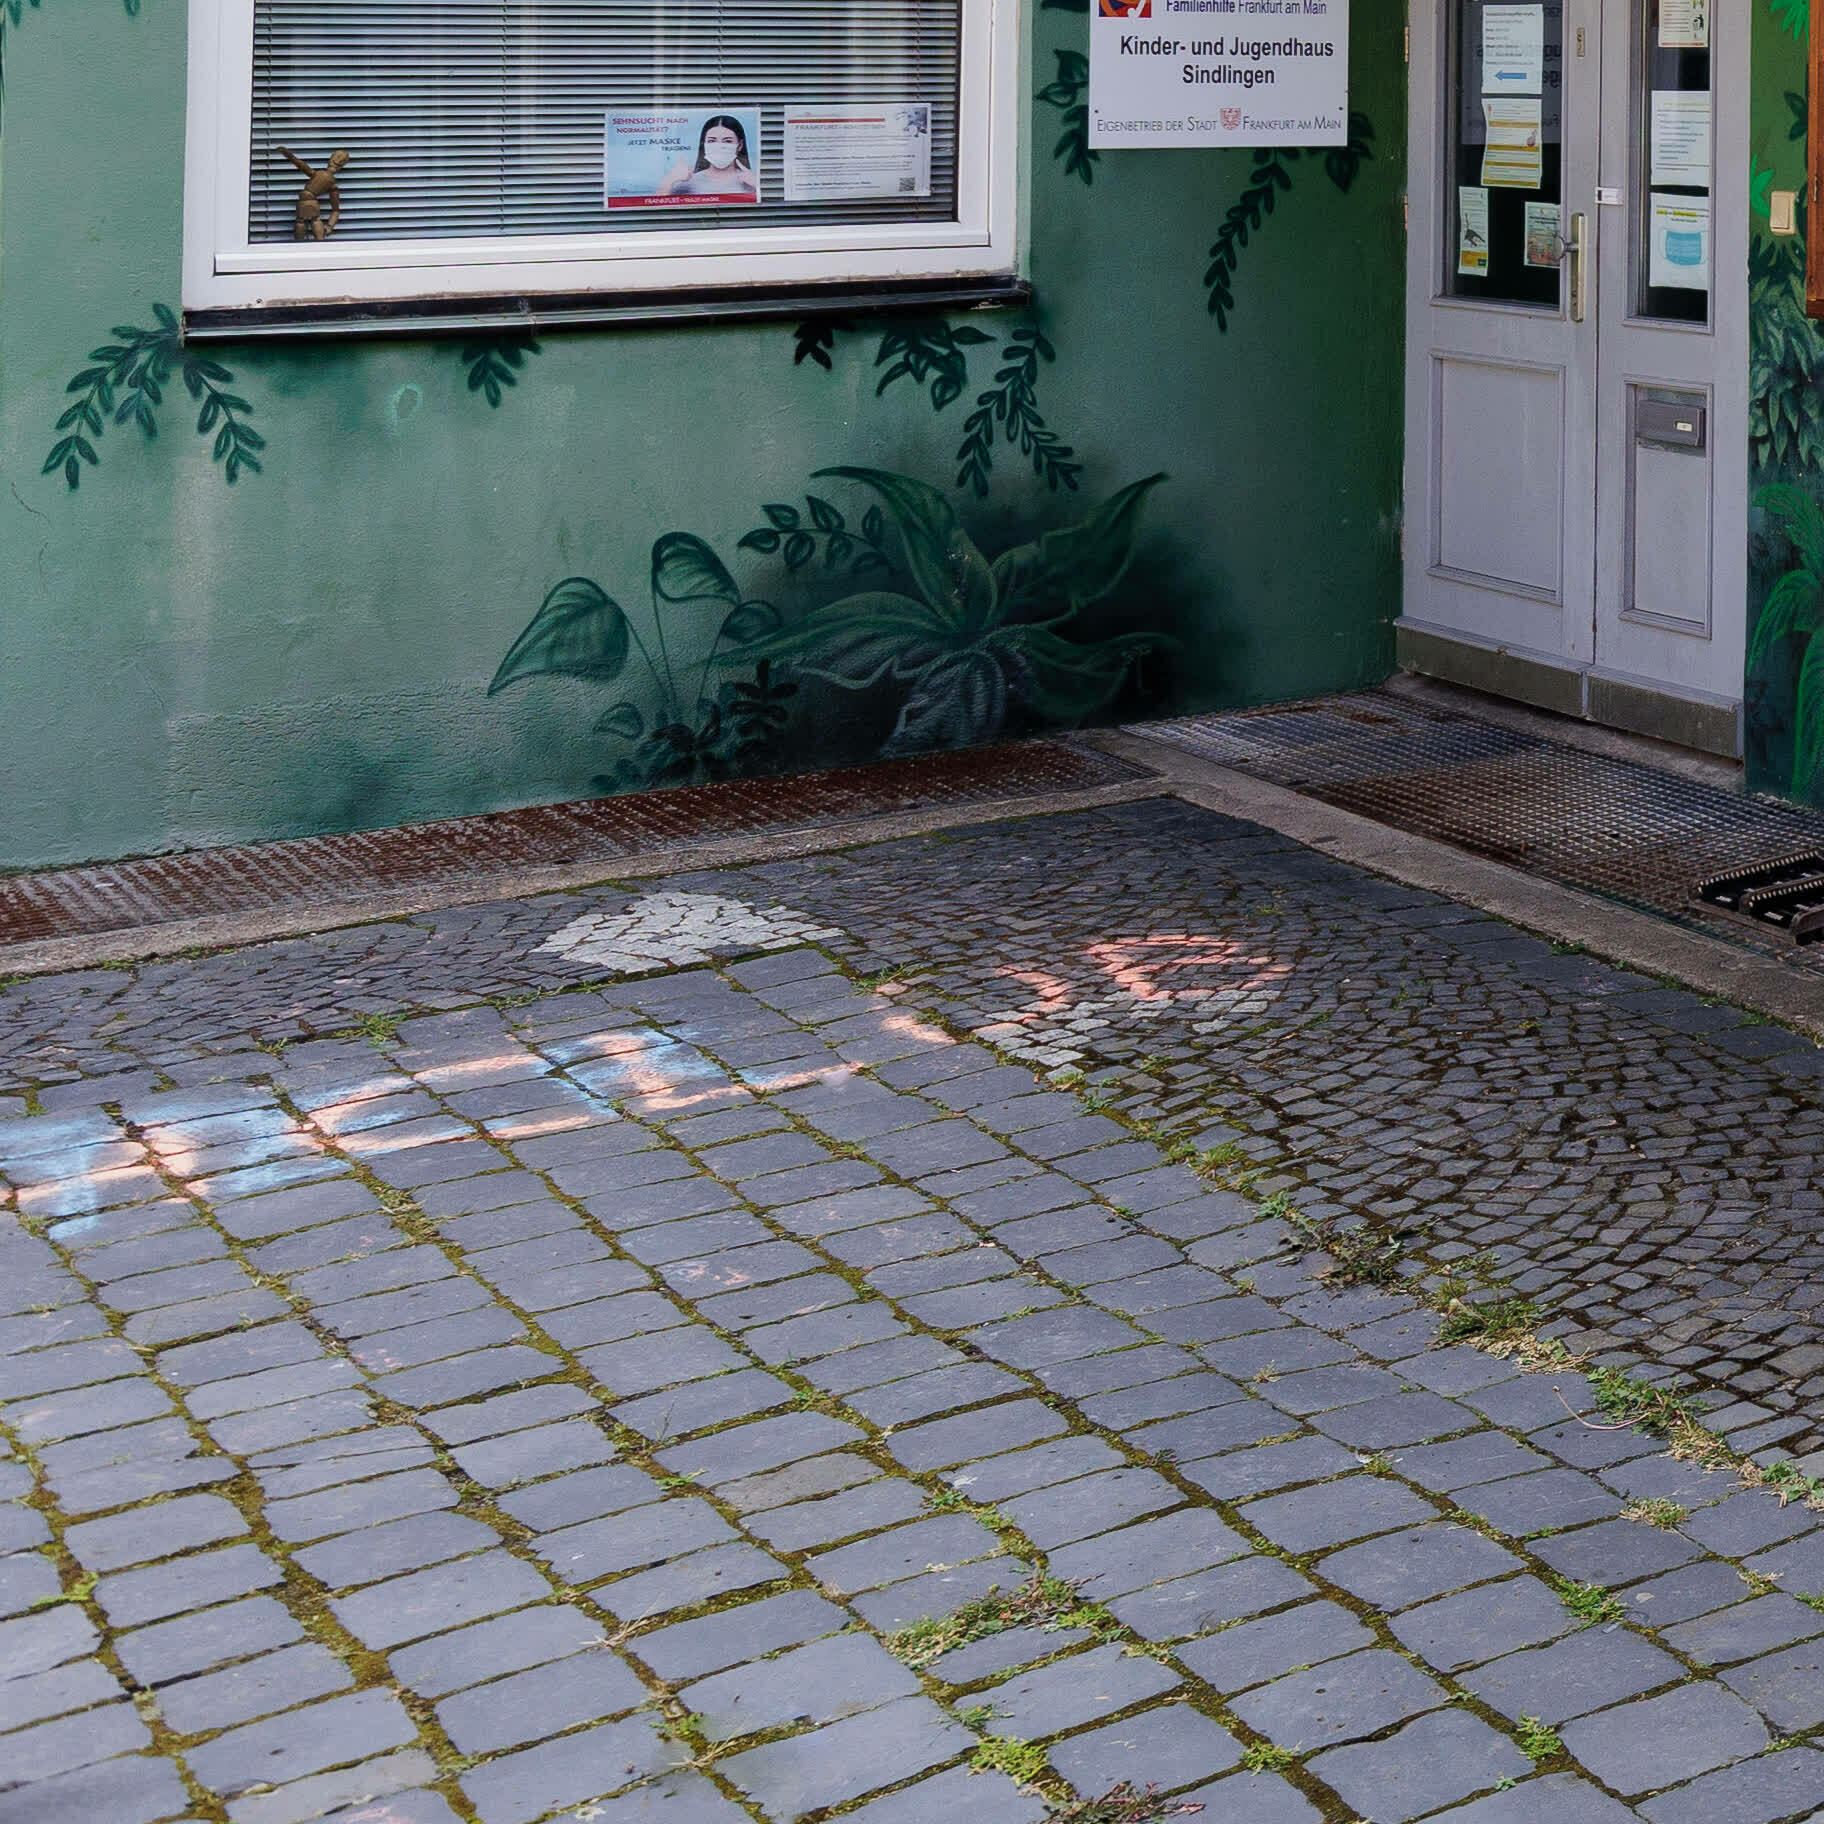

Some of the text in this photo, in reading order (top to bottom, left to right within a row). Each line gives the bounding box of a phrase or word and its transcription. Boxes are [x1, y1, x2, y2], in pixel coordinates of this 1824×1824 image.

[1285, 2, 1301, 14] am
[1302, 0, 1327, 15] Main
[1120, 35, 1334, 61] Kinder- und Jugendhaus
[1182, 64, 1275, 88] Sindlingen
[1187, 116, 1217, 131] STADT
[1243, 116, 1296, 130] FRANKFURT
[1314, 115, 1341, 129] MAIN
